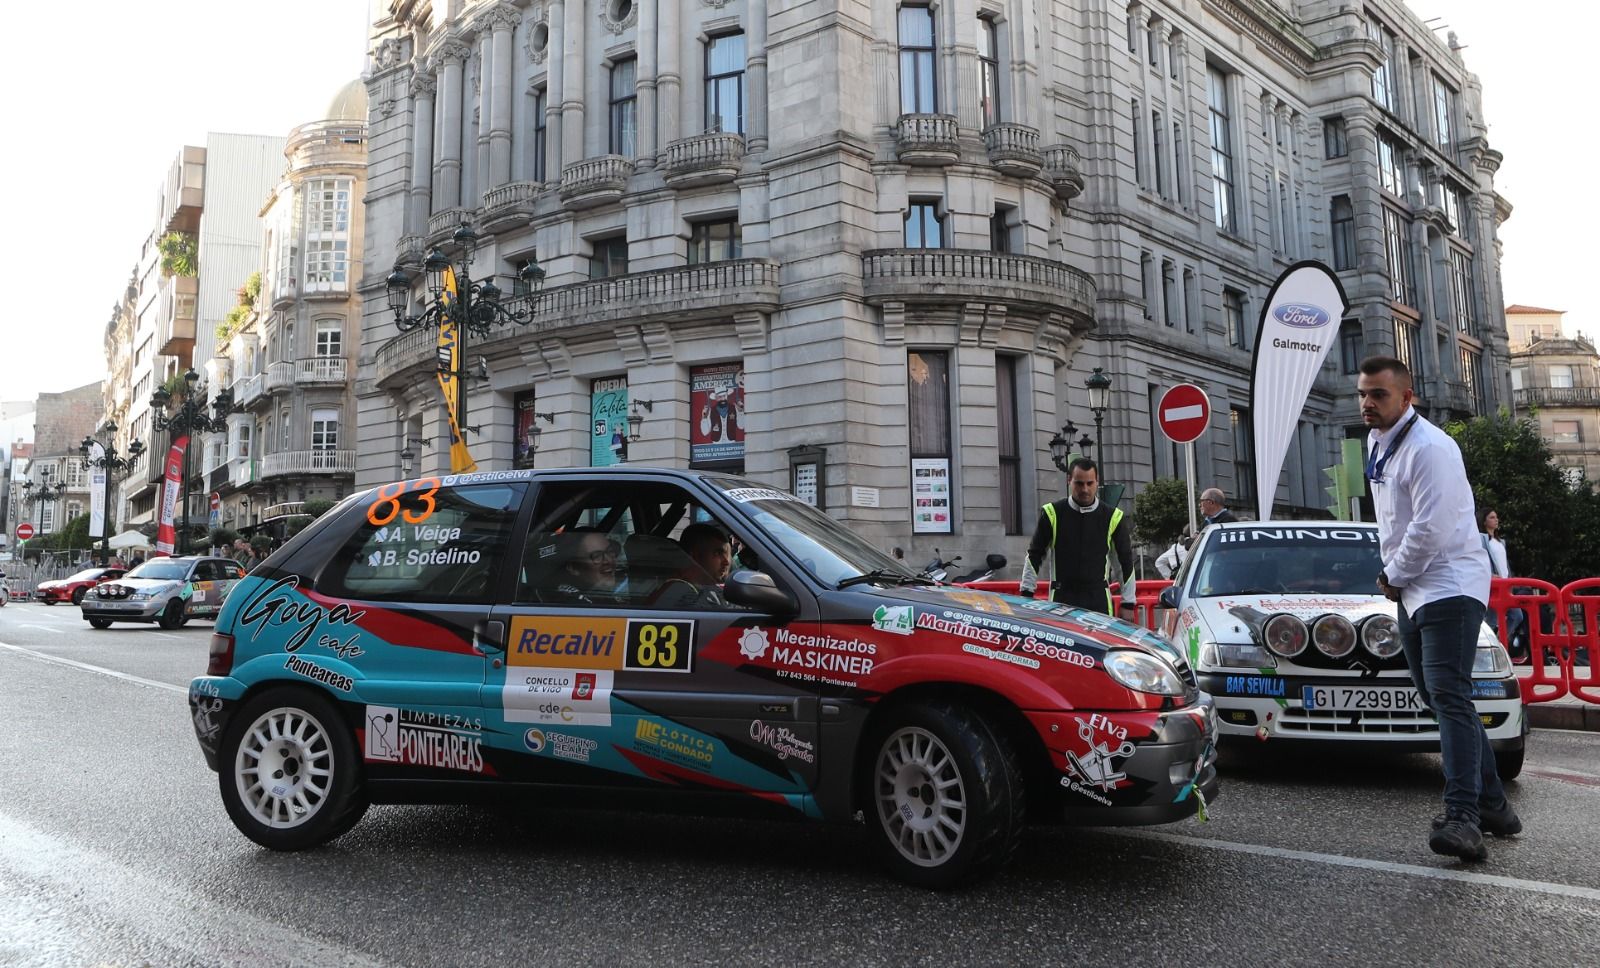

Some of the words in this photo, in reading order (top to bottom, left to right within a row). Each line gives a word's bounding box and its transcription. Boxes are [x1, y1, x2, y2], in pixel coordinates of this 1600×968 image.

[1283, 305, 1318, 325] Ford
[1272, 337, 1322, 353] Galmotor
[595, 424, 606, 434] 30
[458, 470, 531, 485] @estiloelva
[367, 477, 442, 526] 83
[388, 526, 405, 542] A.
[414, 525, 461, 545] Veiga
[383, 550, 399, 566] B.
[406, 548, 480, 566] Sotelino
[241, 574, 367, 653] Goya
[916, 612, 1003, 645] Martínez
[1007, 635, 1021, 652] y
[1022, 637, 1095, 669] Seoane
[943, 610, 1075, 647] CONSTRUCCIONES
[516, 628, 617, 657] Recalvi
[637, 624, 678, 667] 83
[776, 628, 877, 655] Mecanizados
[772, 646, 874, 675] MASKINER
[962, 643, 990, 657] OBRAS
[997, 652, 1040, 669] REFORMAS
[284, 653, 354, 692] Ponteareas
[525, 676, 569, 686] CONCELLO
[821, 676, 857, 688] Ponteareas
[198, 679, 220, 698] Elva
[1226, 676, 1245, 694] BAR
[1246, 677, 1285, 696] SEVILLA
[400, 708, 482, 731] LIMPIEZAS
[1089, 713, 1128, 740] Elva
[400, 728, 484, 773] PONTEAREAS
[553, 742, 589, 756] REALE
[660, 739, 713, 763] CONDADO
[1070, 783, 1113, 807] @estiloelva
